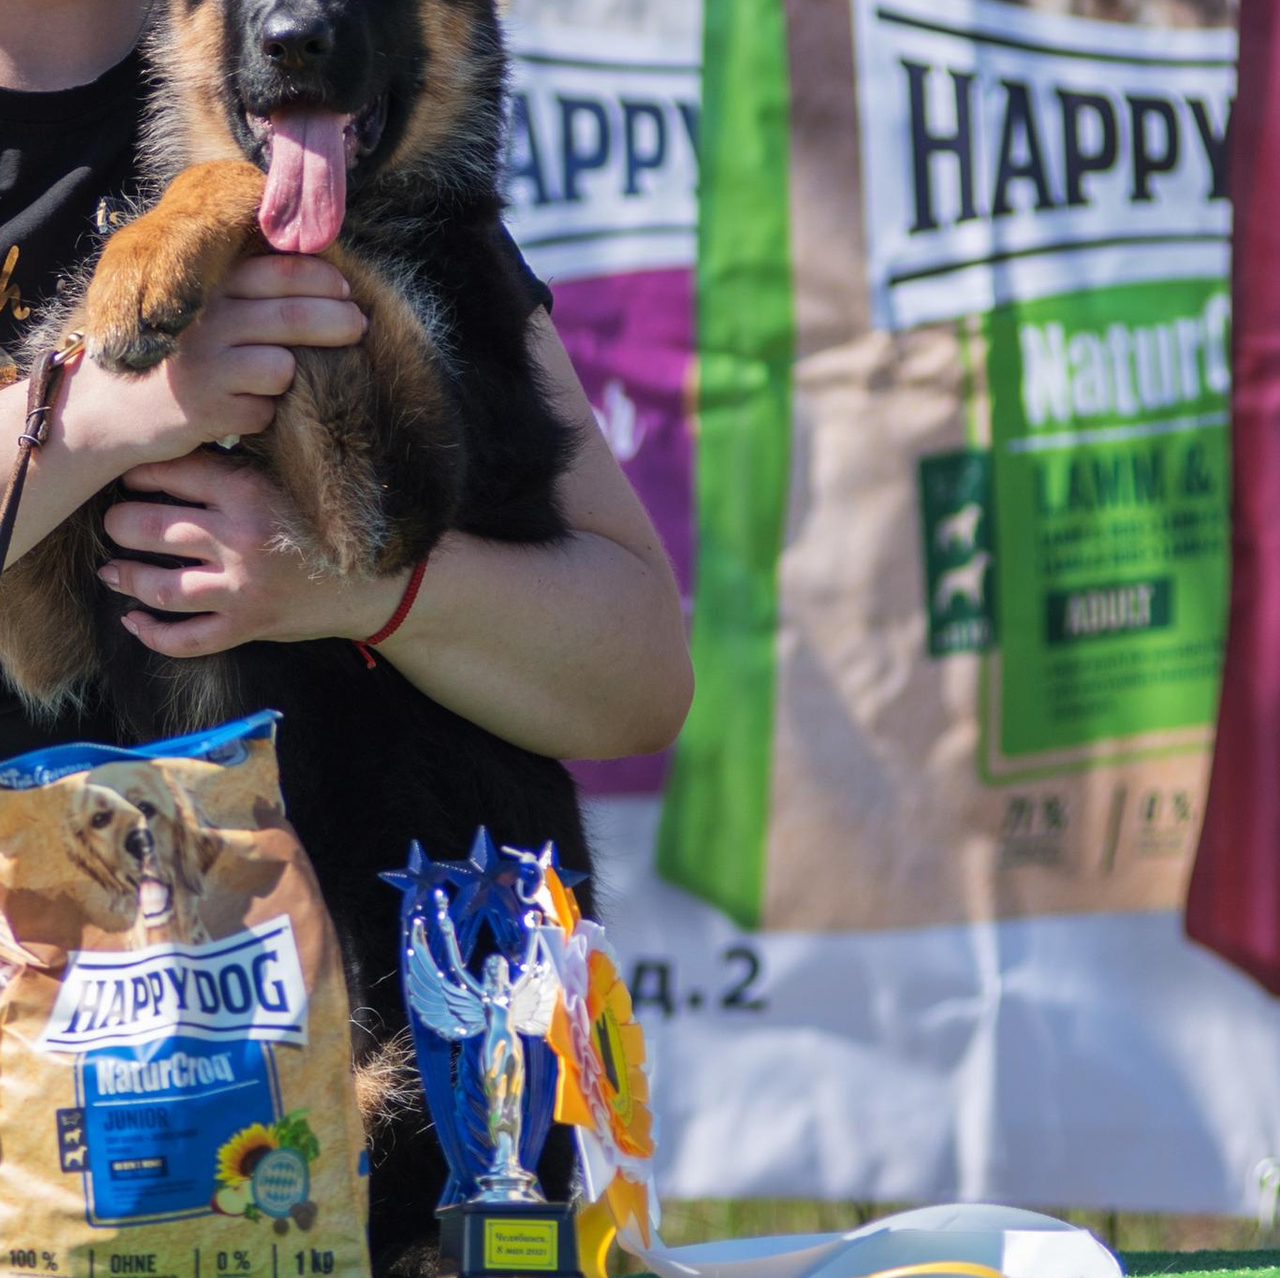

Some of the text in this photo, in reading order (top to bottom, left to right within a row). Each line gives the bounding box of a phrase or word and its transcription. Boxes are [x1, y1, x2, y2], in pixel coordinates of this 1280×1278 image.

[899, 60, 1231, 234] HAPPY
[1064, 583, 1157, 636] ADULT
[61, 950, 290, 1034] HAPPY DOG
[96, 1051, 235, 1096] NaturCroq
[104, 1107, 169, 1132] JUNIOR
[9, 1249, 58, 1271] 100 %
[110, 1254, 156, 1273] OHNE
[217, 1251, 251, 1270] 0 %
[295, 1248, 334, 1275] 1 kg
